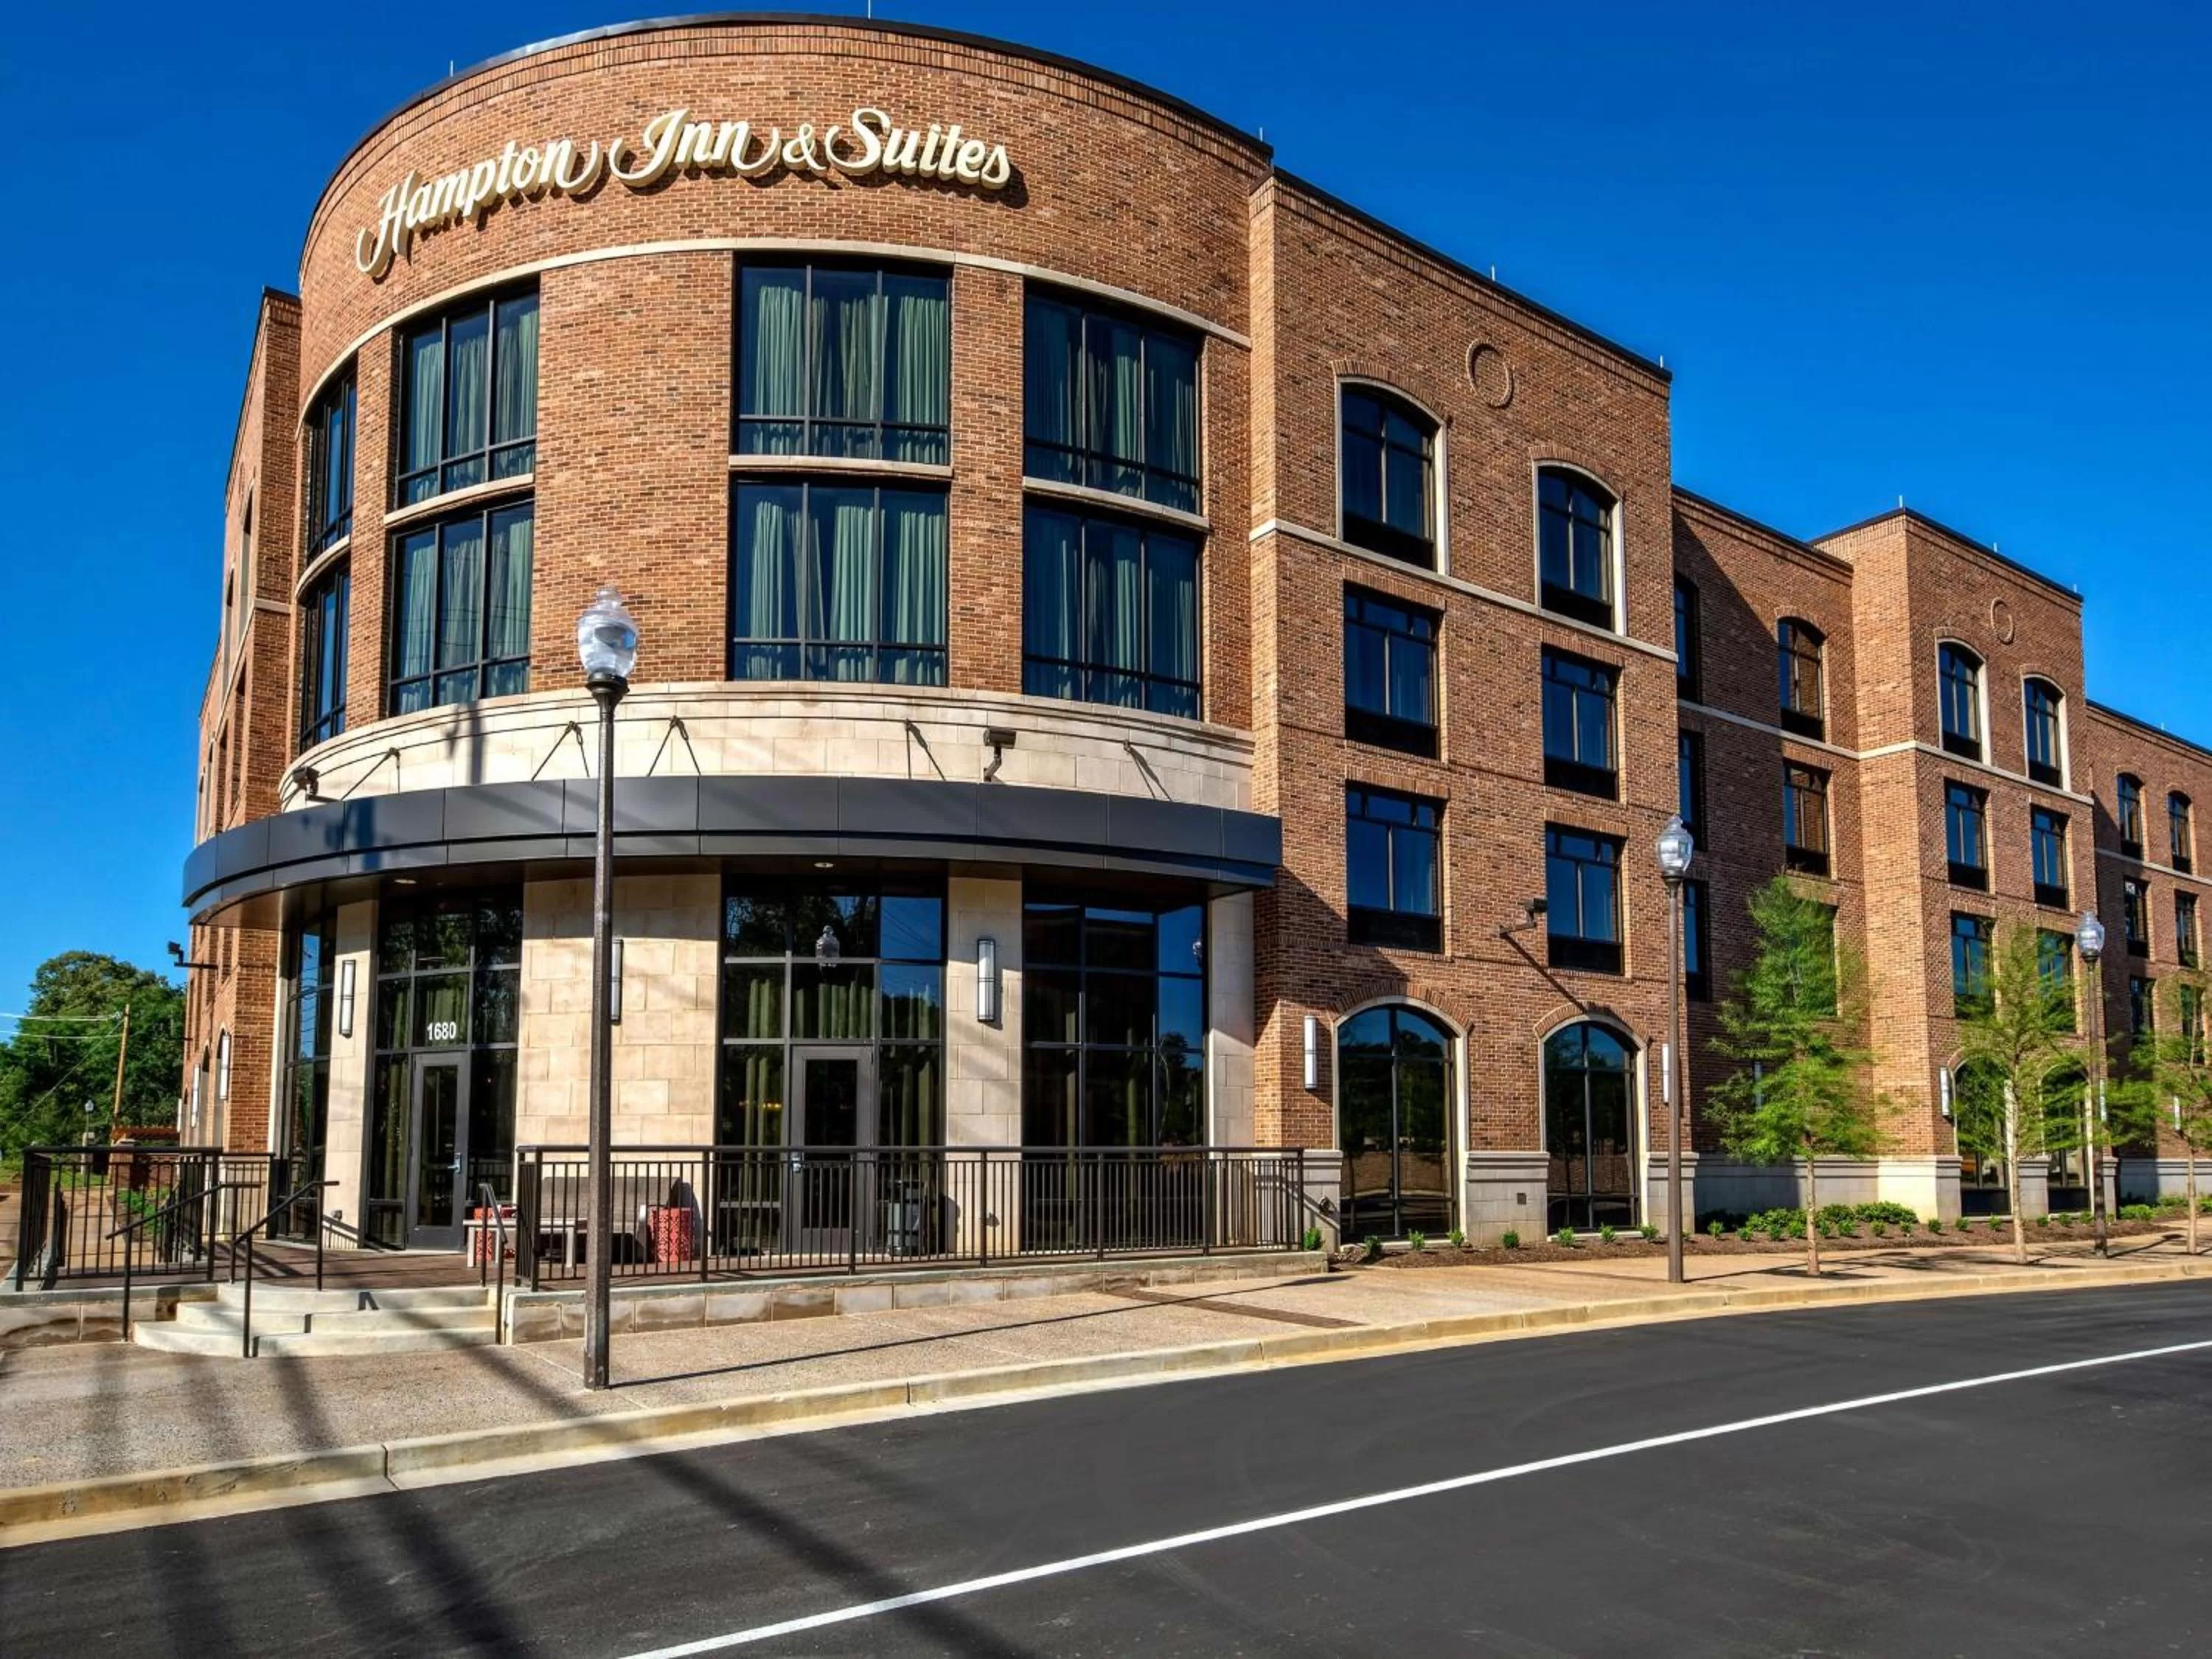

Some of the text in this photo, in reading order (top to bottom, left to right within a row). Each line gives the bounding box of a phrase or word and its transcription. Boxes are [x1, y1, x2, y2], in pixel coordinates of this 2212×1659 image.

[355, 107, 1012, 277] Hampton Inn & Suites
[427, 1021, 456, 1040] 1680
